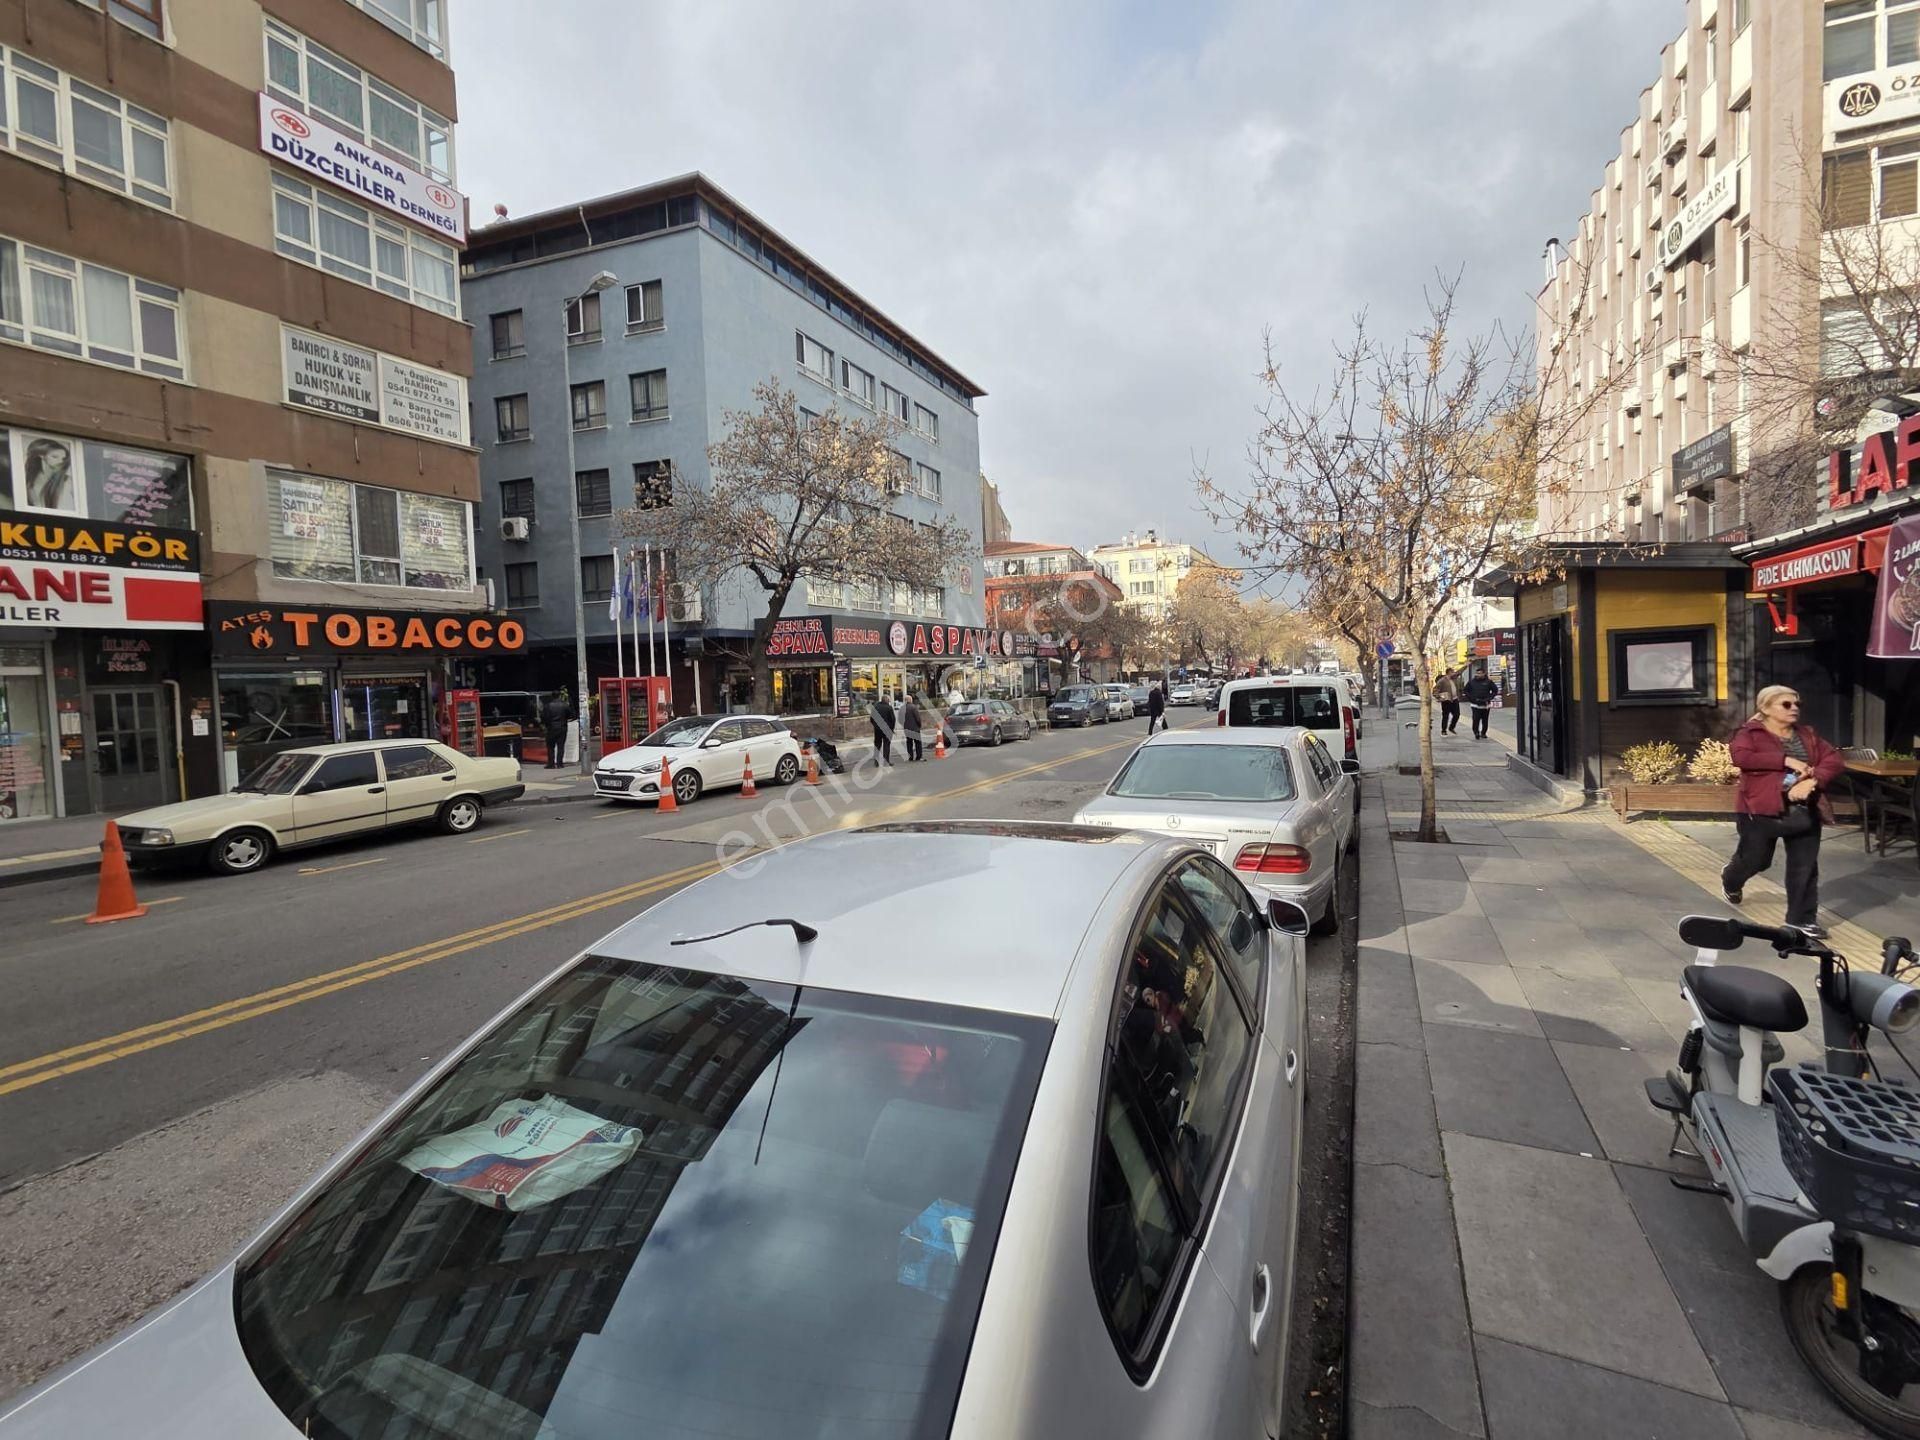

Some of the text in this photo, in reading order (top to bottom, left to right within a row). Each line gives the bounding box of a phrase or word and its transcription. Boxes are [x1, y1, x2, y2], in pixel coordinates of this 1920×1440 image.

[334, 141, 406, 184] ANKARA
[272, 132, 457, 233] DÜZCELİLER DERNEĞİ
[434, 190, 449, 205] 81
[291, 337, 372, 373] BAKIRCI & SORAN
[305, 358, 361, 385] HUKUK VE
[394, 365, 448, 388] Av. Özgürcan
[295, 372, 372, 404] DANIŞMANLIK
[388, 382, 410, 394] 0545
[329, 399, 336, 411] 2
[338, 403, 355, 415] No:
[357, 408, 364, 418] 5
[393, 398, 452, 419] Av. Barış Cem
[409, 411, 438, 425] SORAN
[282, 499, 325, 513] SATILIK
[0, 522, 190, 561] KUAFÖR
[2, 548, 107, 564] 0531 101 88 72
[1781, 548, 1851, 582] LAHMACUN
[221, 610, 273, 632] ATEŞ
[282, 611, 525, 650] TOBACCO
[773, 619, 822, 633] ZENLER
[766, 632, 829, 656] SPAVA
[834, 627, 880, 645] SEZENLER
[912, 624, 1000, 656] ASPAVA
